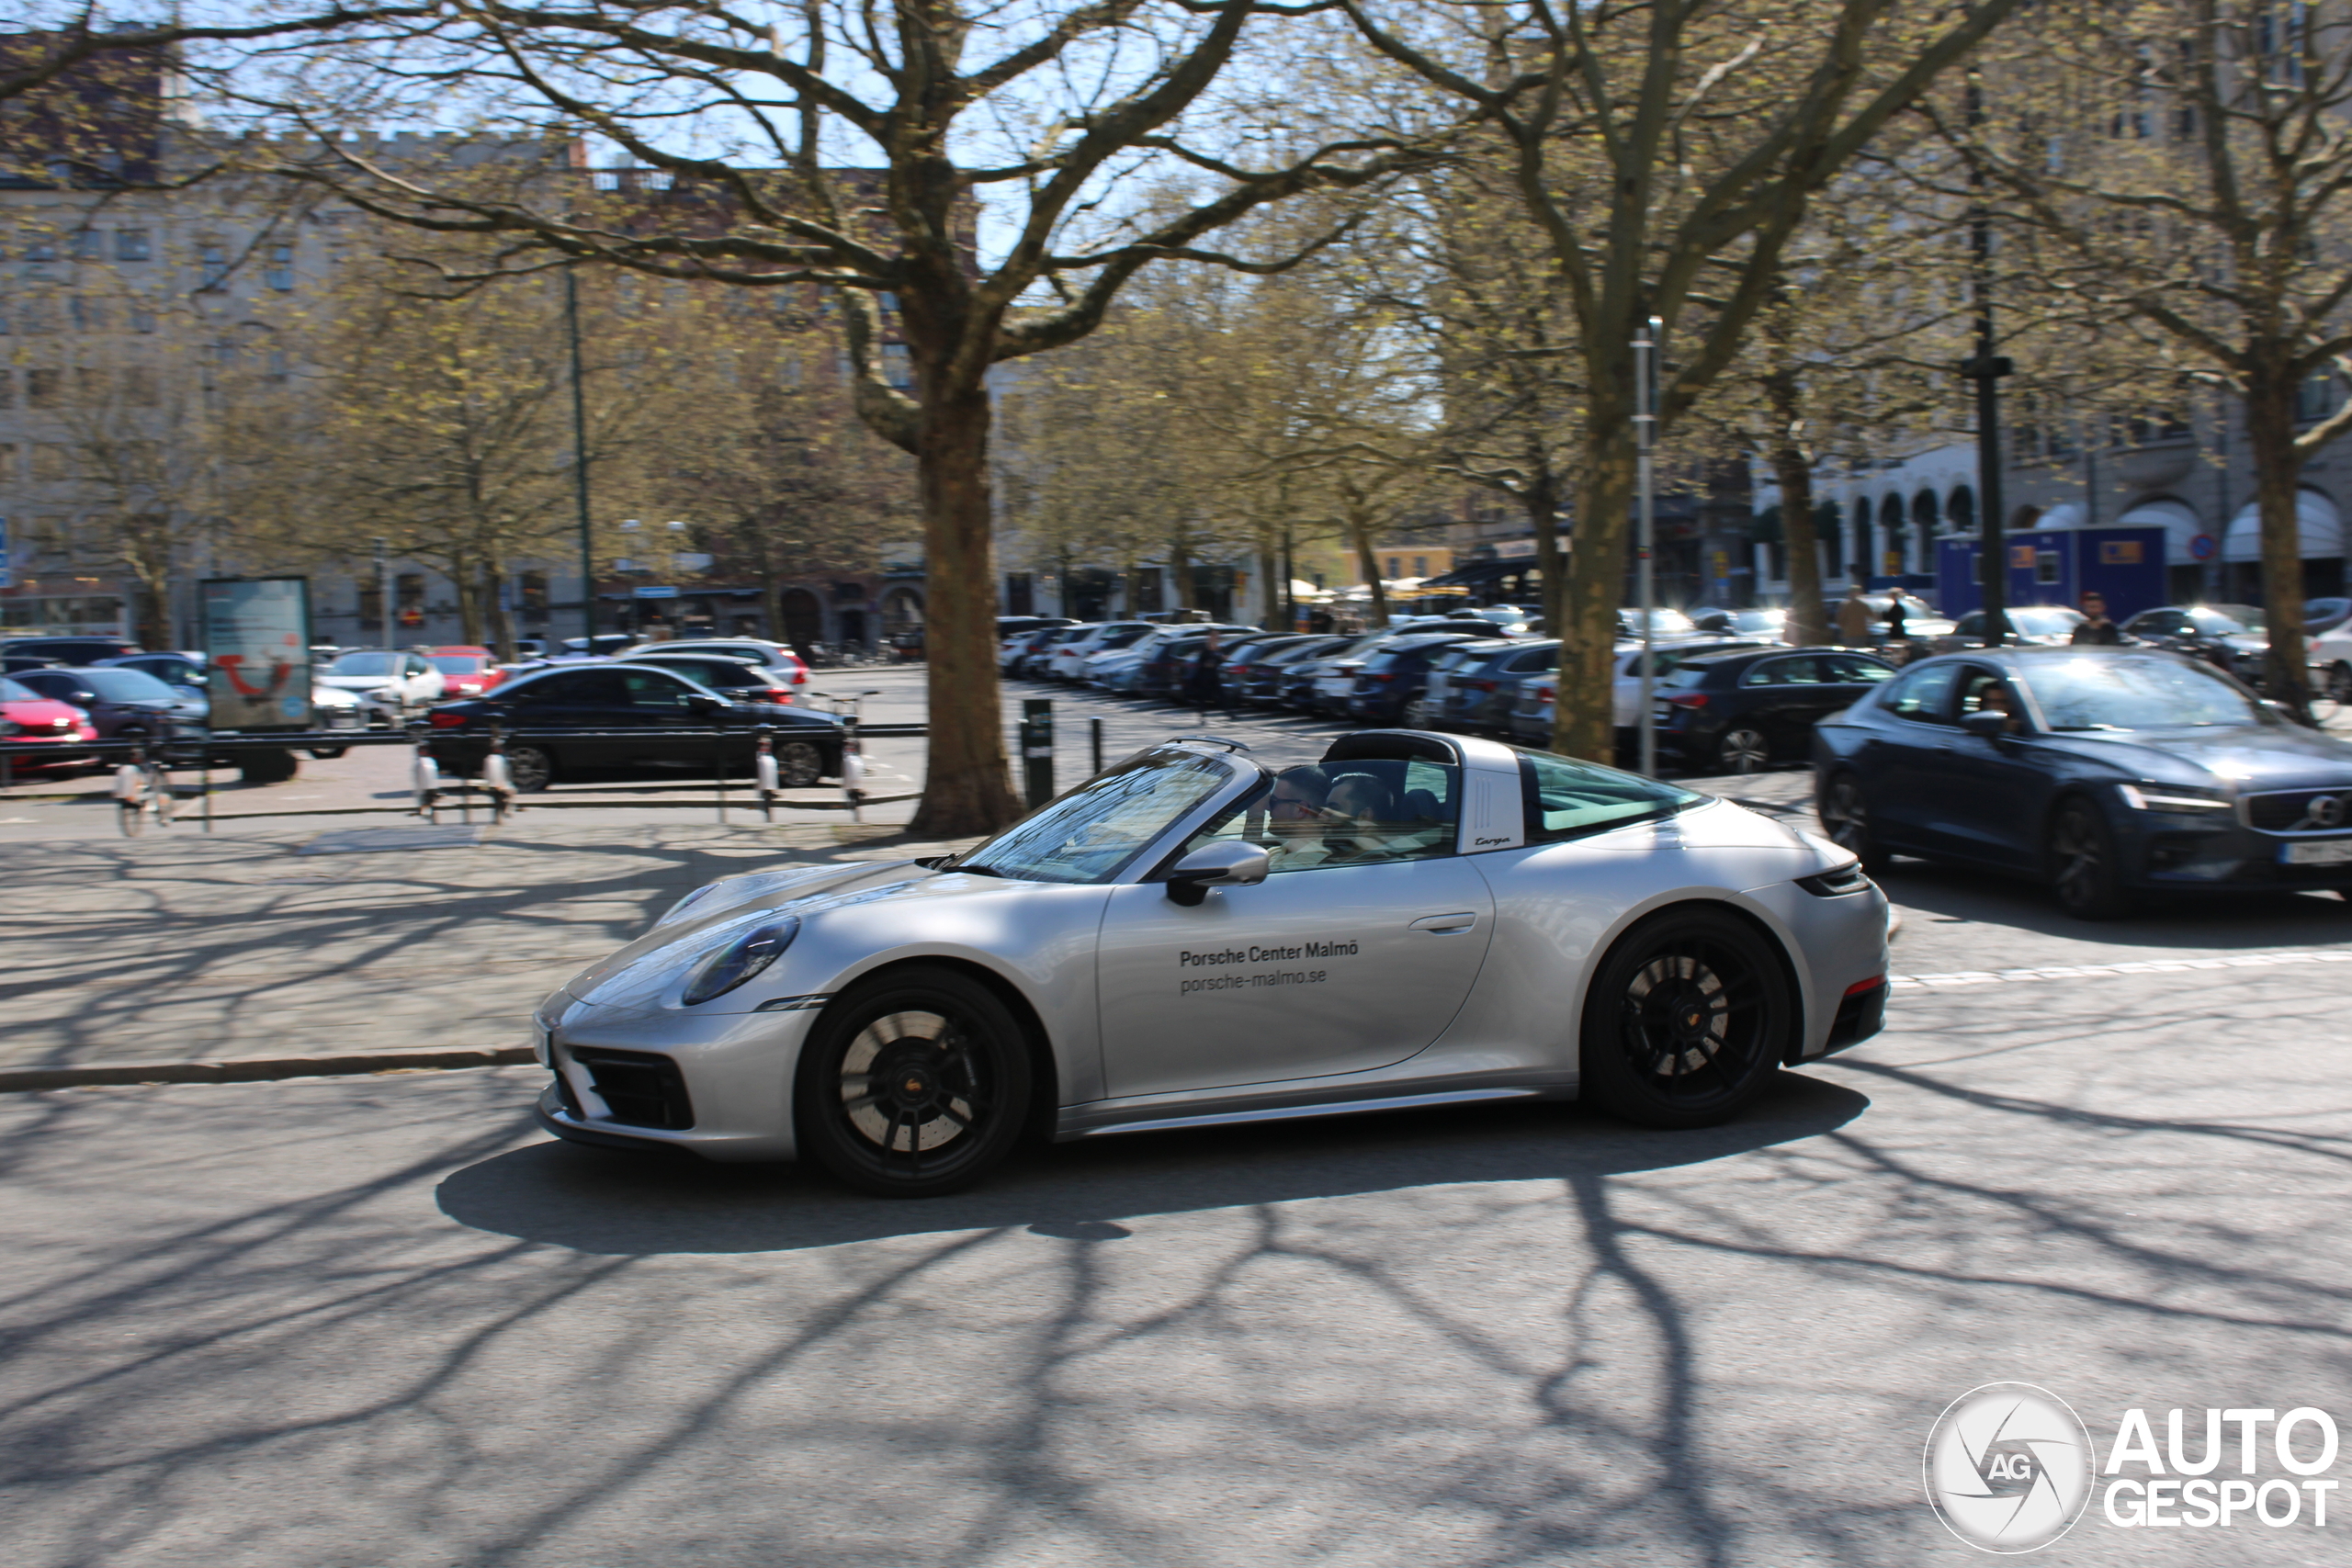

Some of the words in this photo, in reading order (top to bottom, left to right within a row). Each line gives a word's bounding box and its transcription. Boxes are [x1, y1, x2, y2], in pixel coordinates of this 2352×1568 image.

[1180, 948, 1246, 967] Porsche
[1249, 945, 1302, 963] Center
[1305, 940, 1359, 959] Malmö
[1180, 969, 1327, 997] porsche-malmo.se
